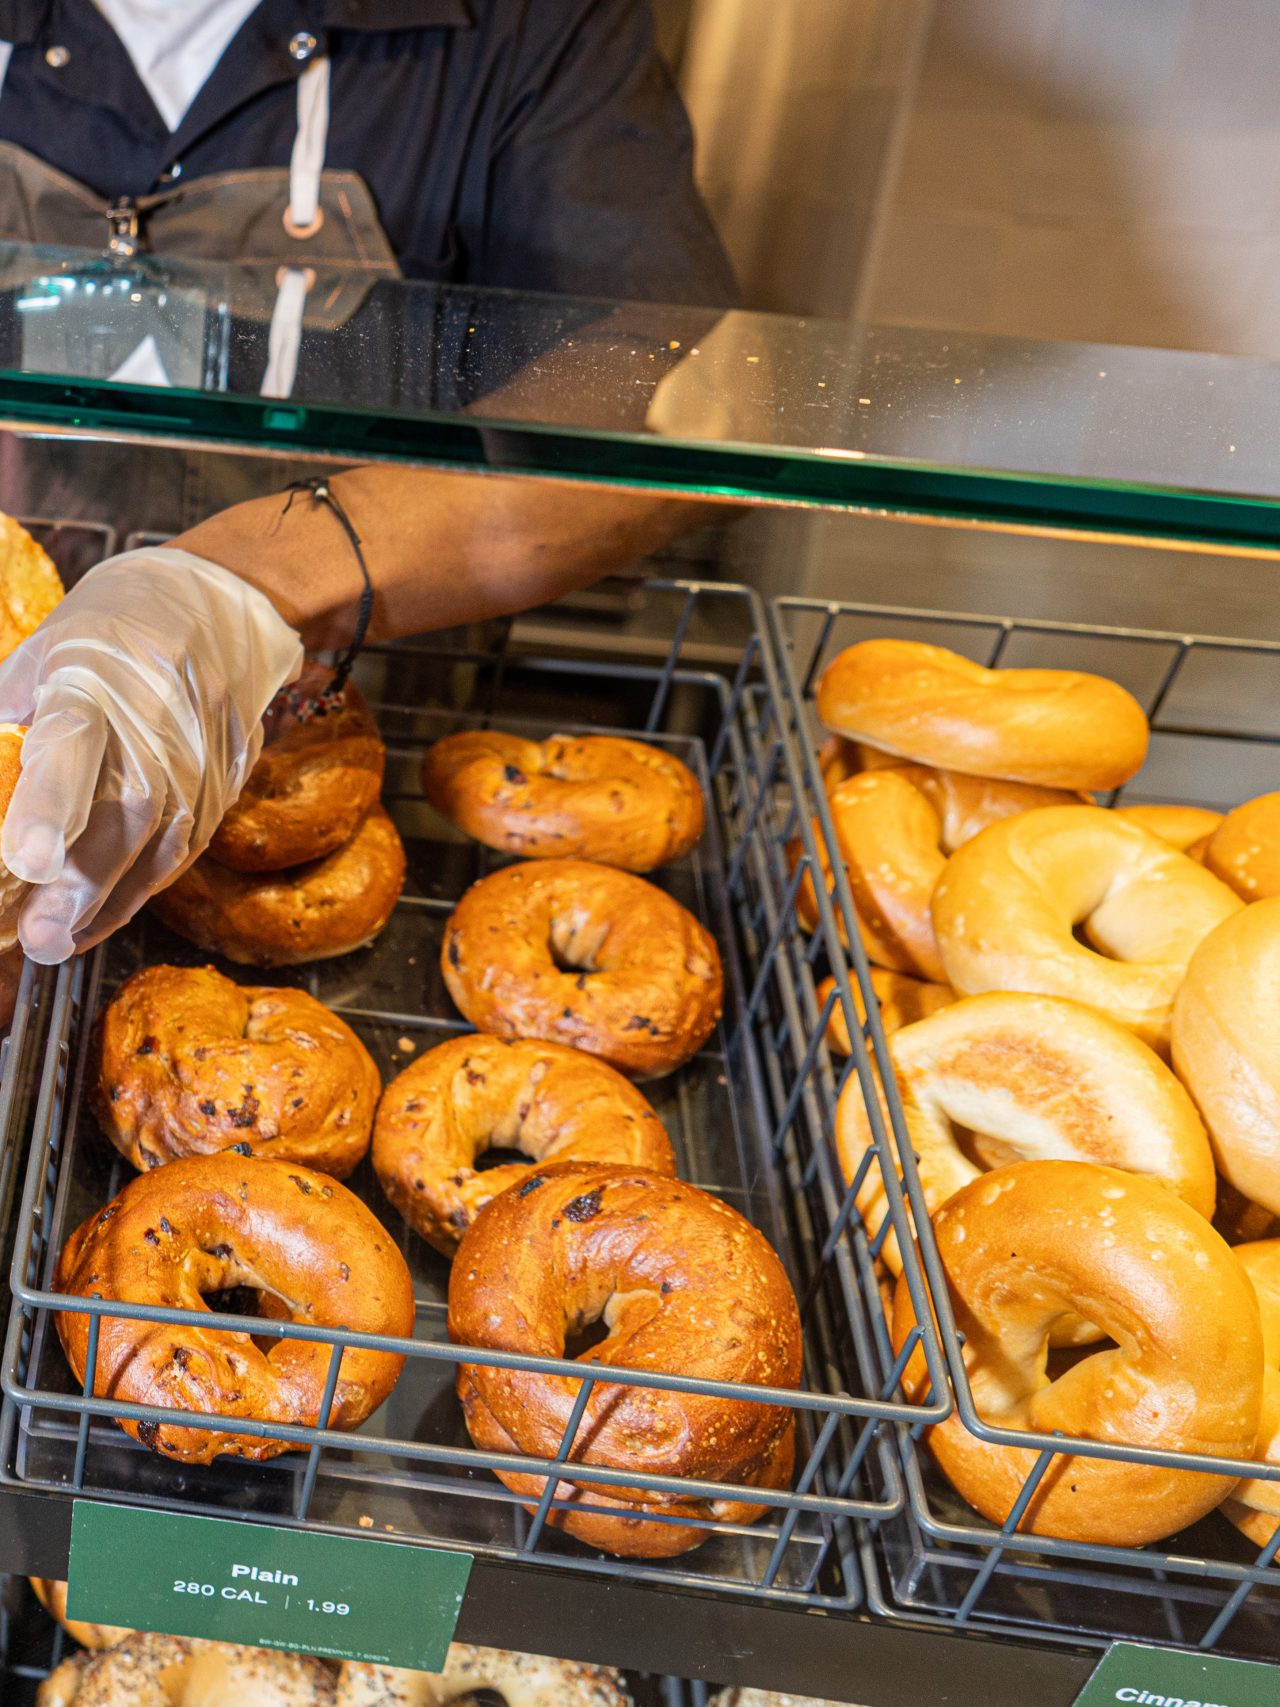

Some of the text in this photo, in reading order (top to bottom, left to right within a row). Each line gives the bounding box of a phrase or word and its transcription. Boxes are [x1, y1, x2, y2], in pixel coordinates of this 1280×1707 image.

[231, 1564, 299, 1587] Plain
[173, 1580, 350, 1615] 280 CAL 1.99
